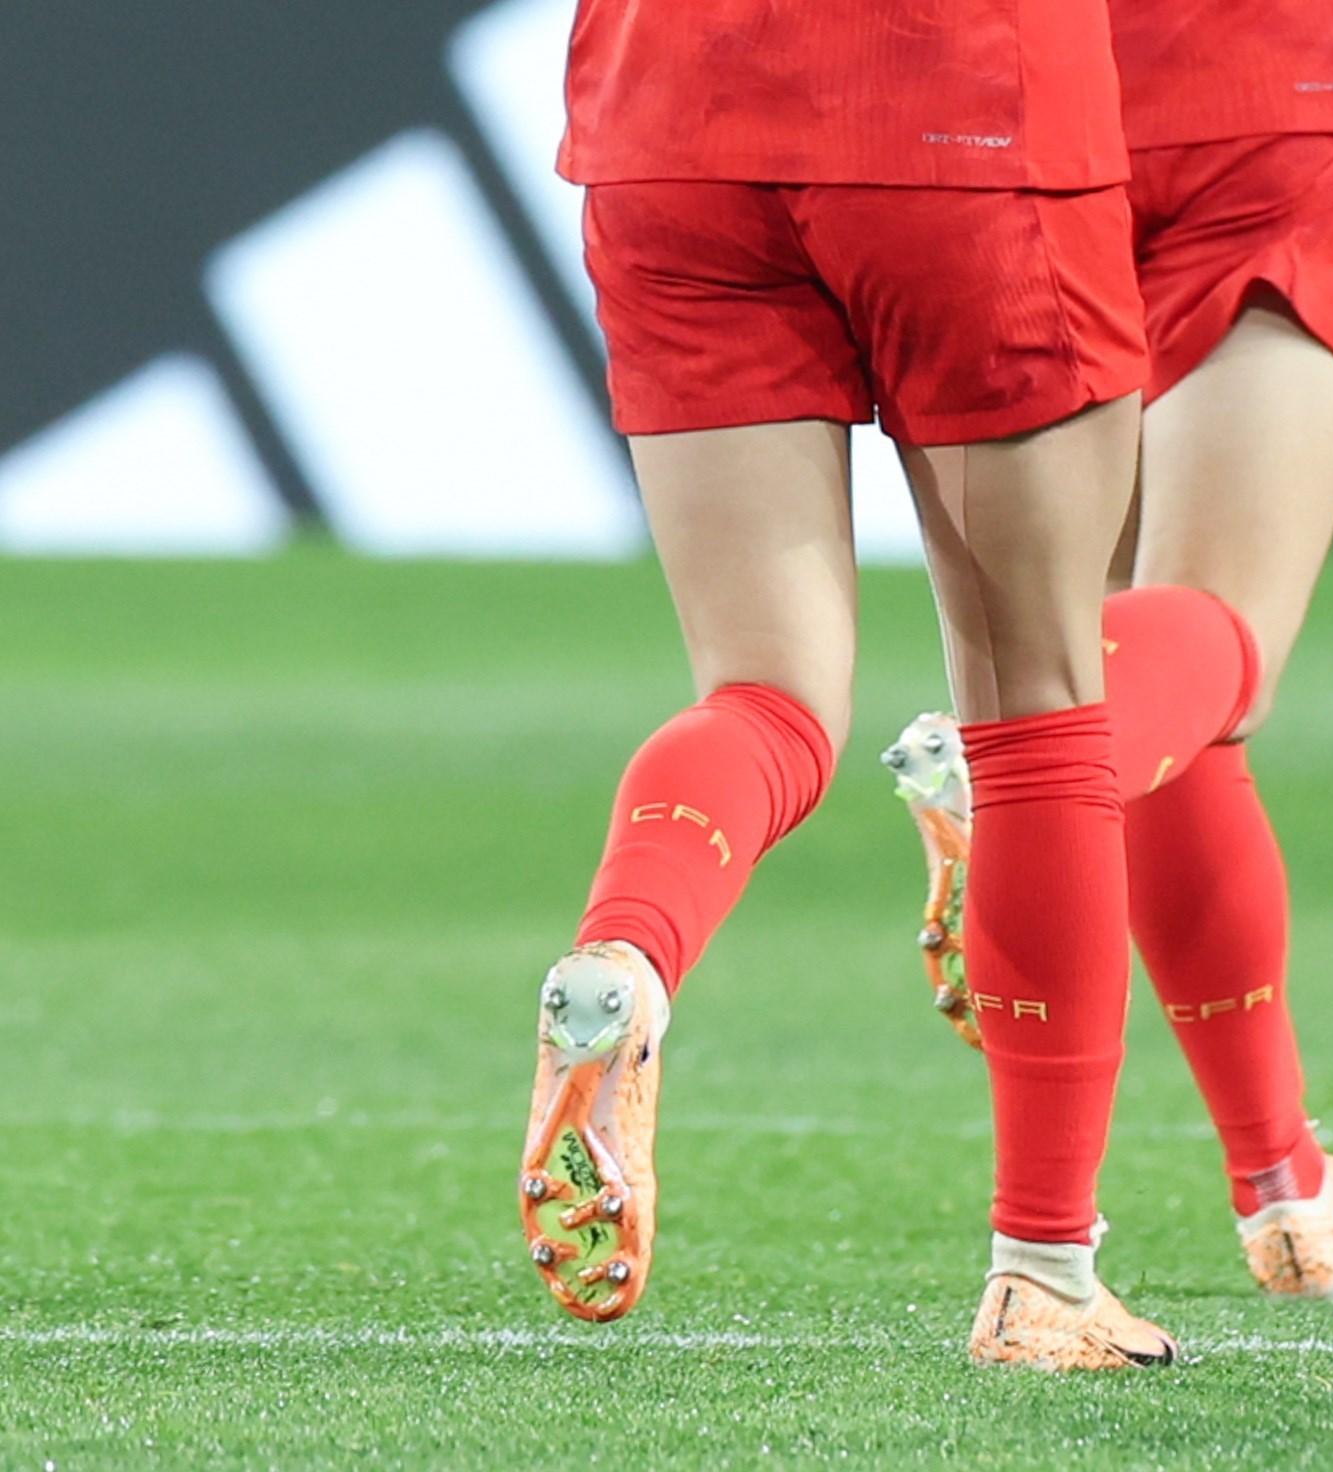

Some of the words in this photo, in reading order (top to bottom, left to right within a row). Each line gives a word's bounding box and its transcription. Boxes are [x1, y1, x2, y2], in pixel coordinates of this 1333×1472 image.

[630, 801, 733, 869] CFA
[966, 991, 1048, 1023] FA
[1164, 983, 1275, 1022] CFA
